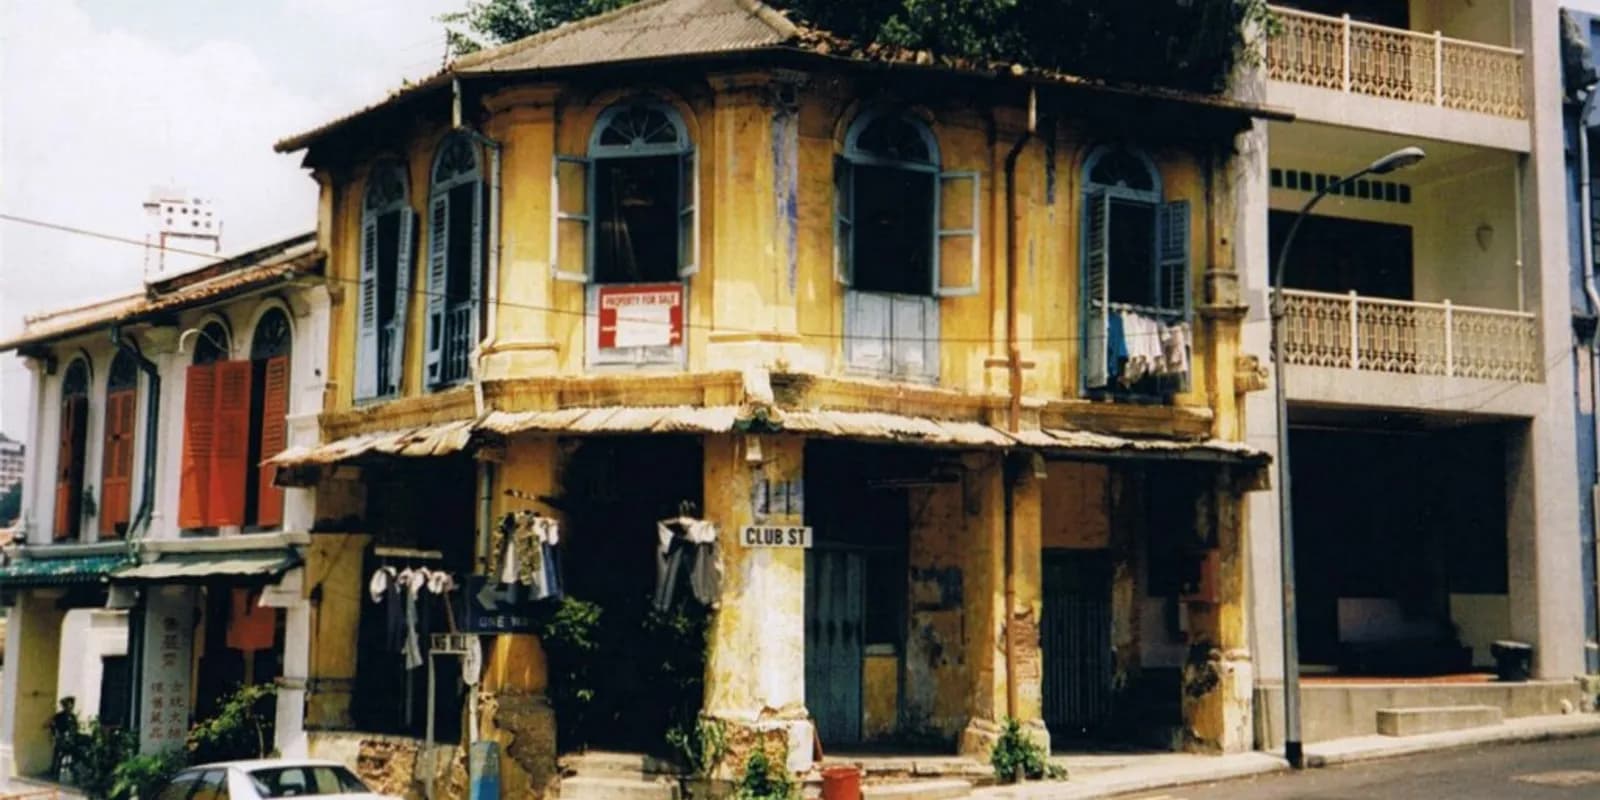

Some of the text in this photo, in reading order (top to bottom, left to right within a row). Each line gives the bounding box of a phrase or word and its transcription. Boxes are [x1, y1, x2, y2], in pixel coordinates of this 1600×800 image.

[605, 294, 676, 306] PROPERTY FOR SALE
[746, 527, 805, 545] CLUB ST
[480, 615, 505, 628] ONE
